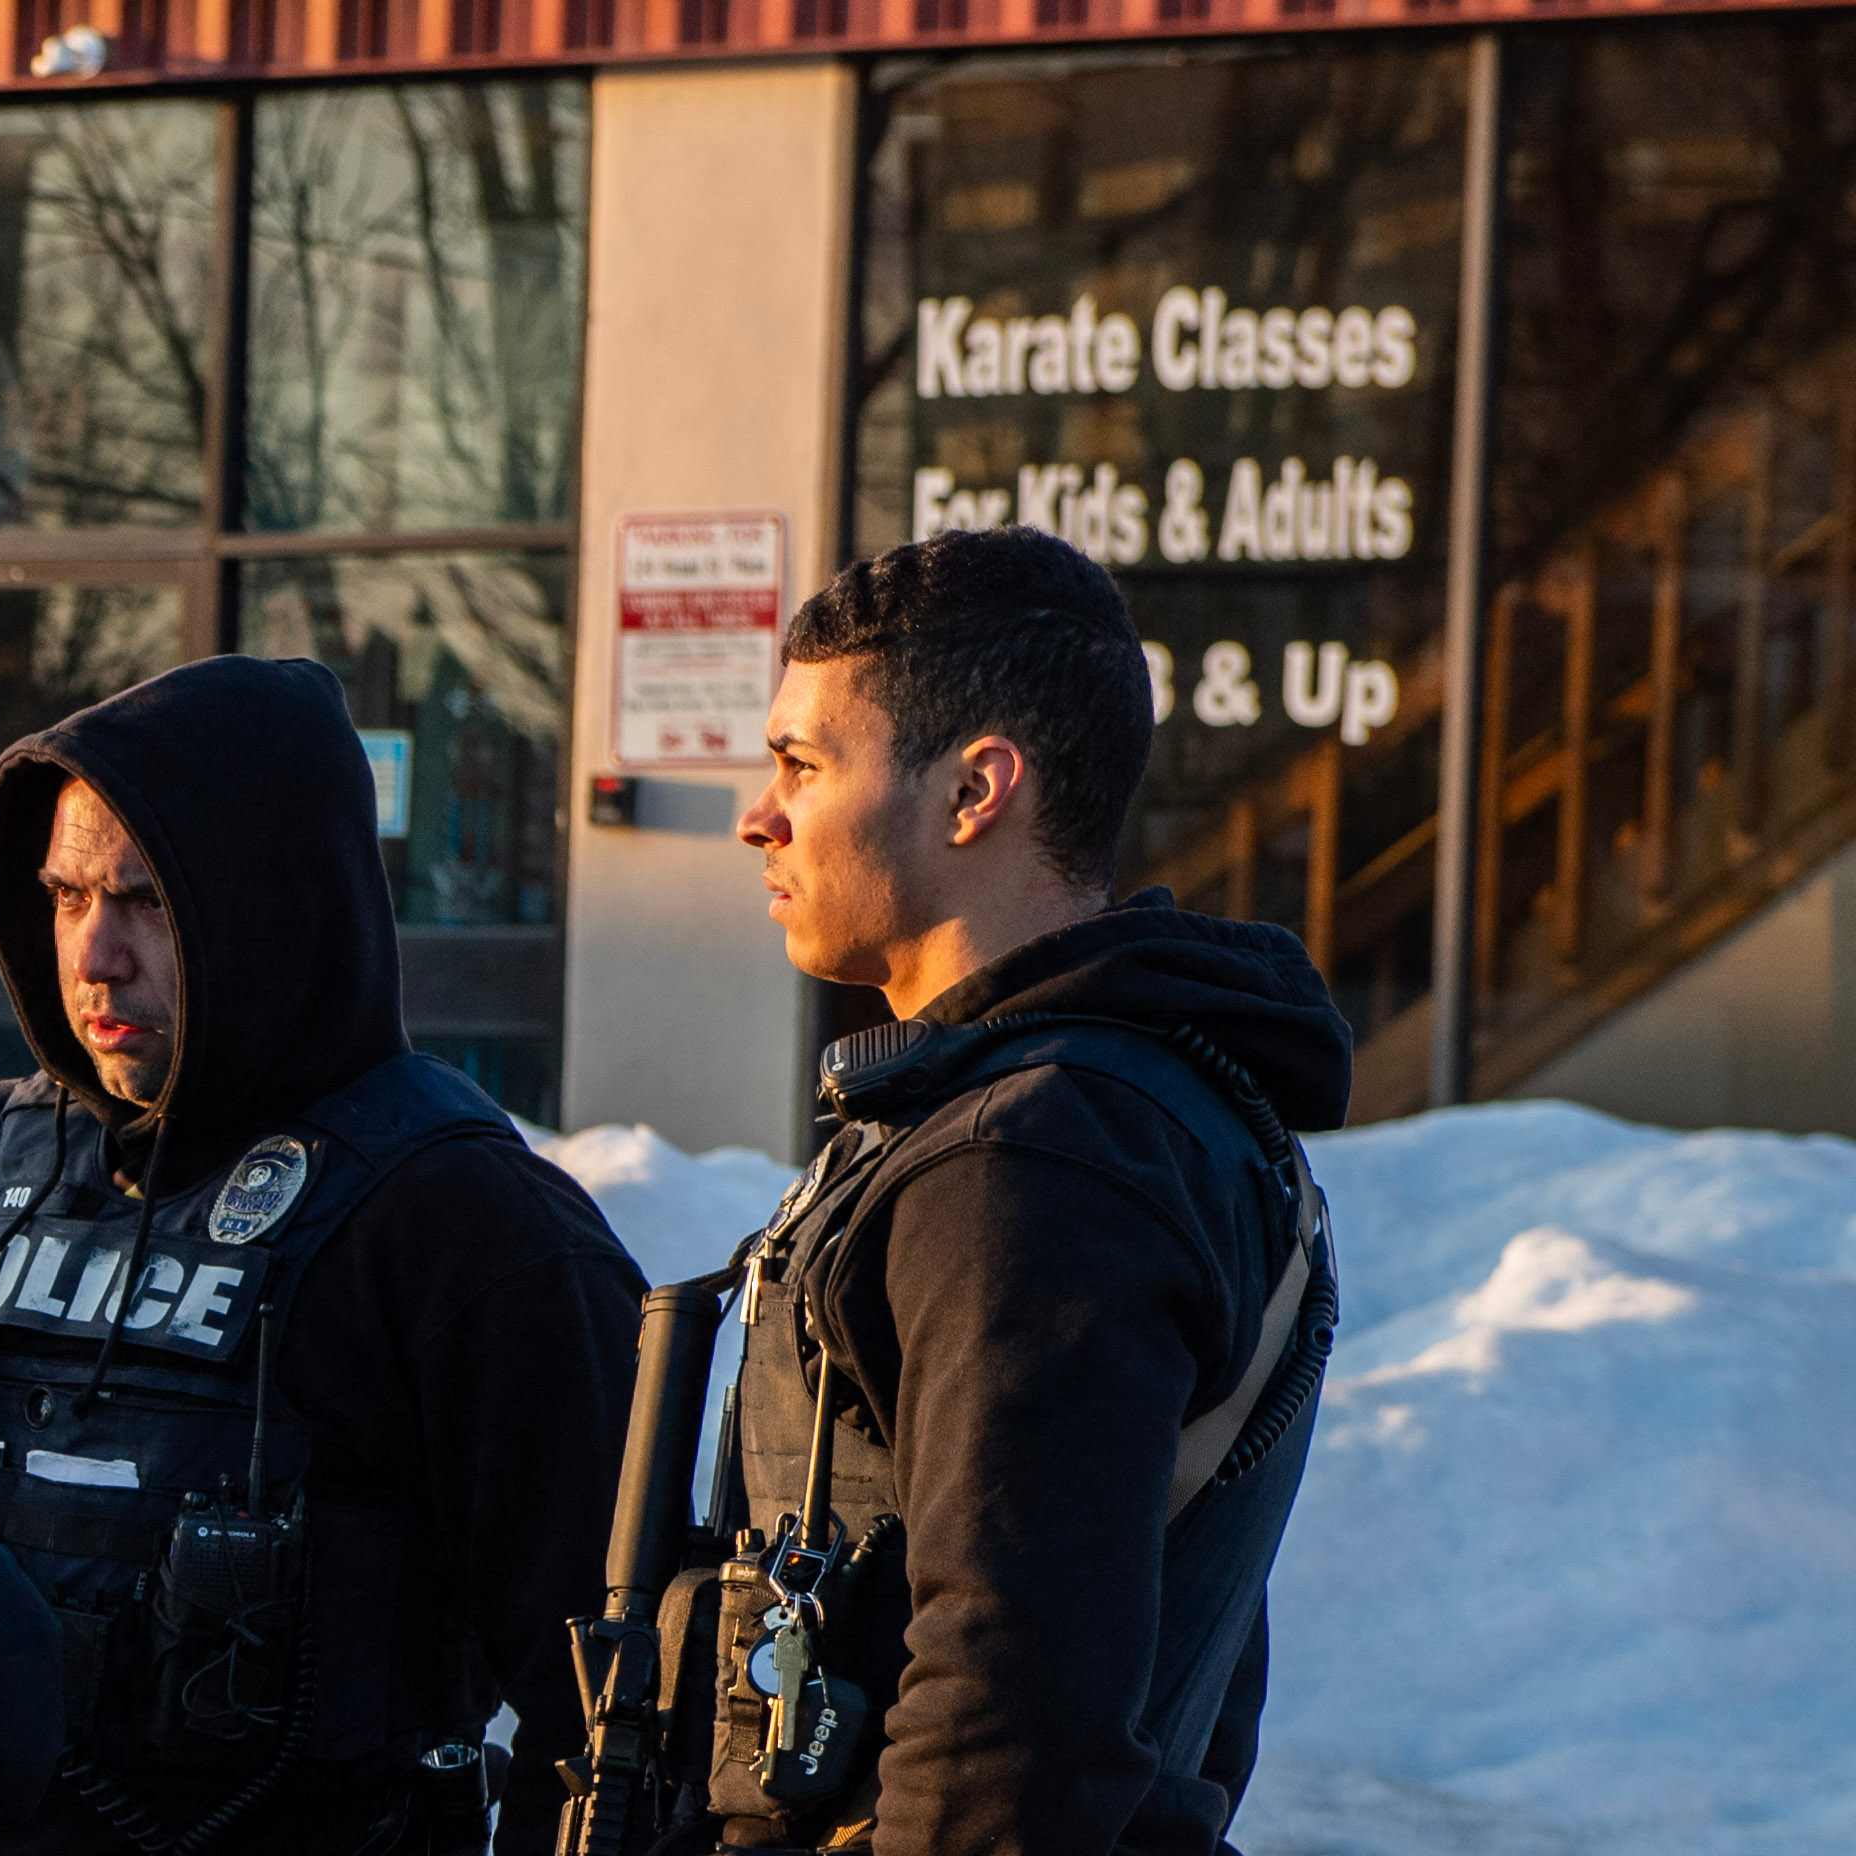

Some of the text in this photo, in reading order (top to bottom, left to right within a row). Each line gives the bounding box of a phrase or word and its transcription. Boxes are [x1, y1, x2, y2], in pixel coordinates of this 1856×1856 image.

[916, 286, 1416, 399] Karate Classes
[912, 455, 1414, 566] For Kids & Adults
[1193, 639, 1261, 728] &
[1282, 640, 1399, 746] Up
[2, 1186, 32, 1208] 140
[799, 1707, 839, 1775] Jeep
